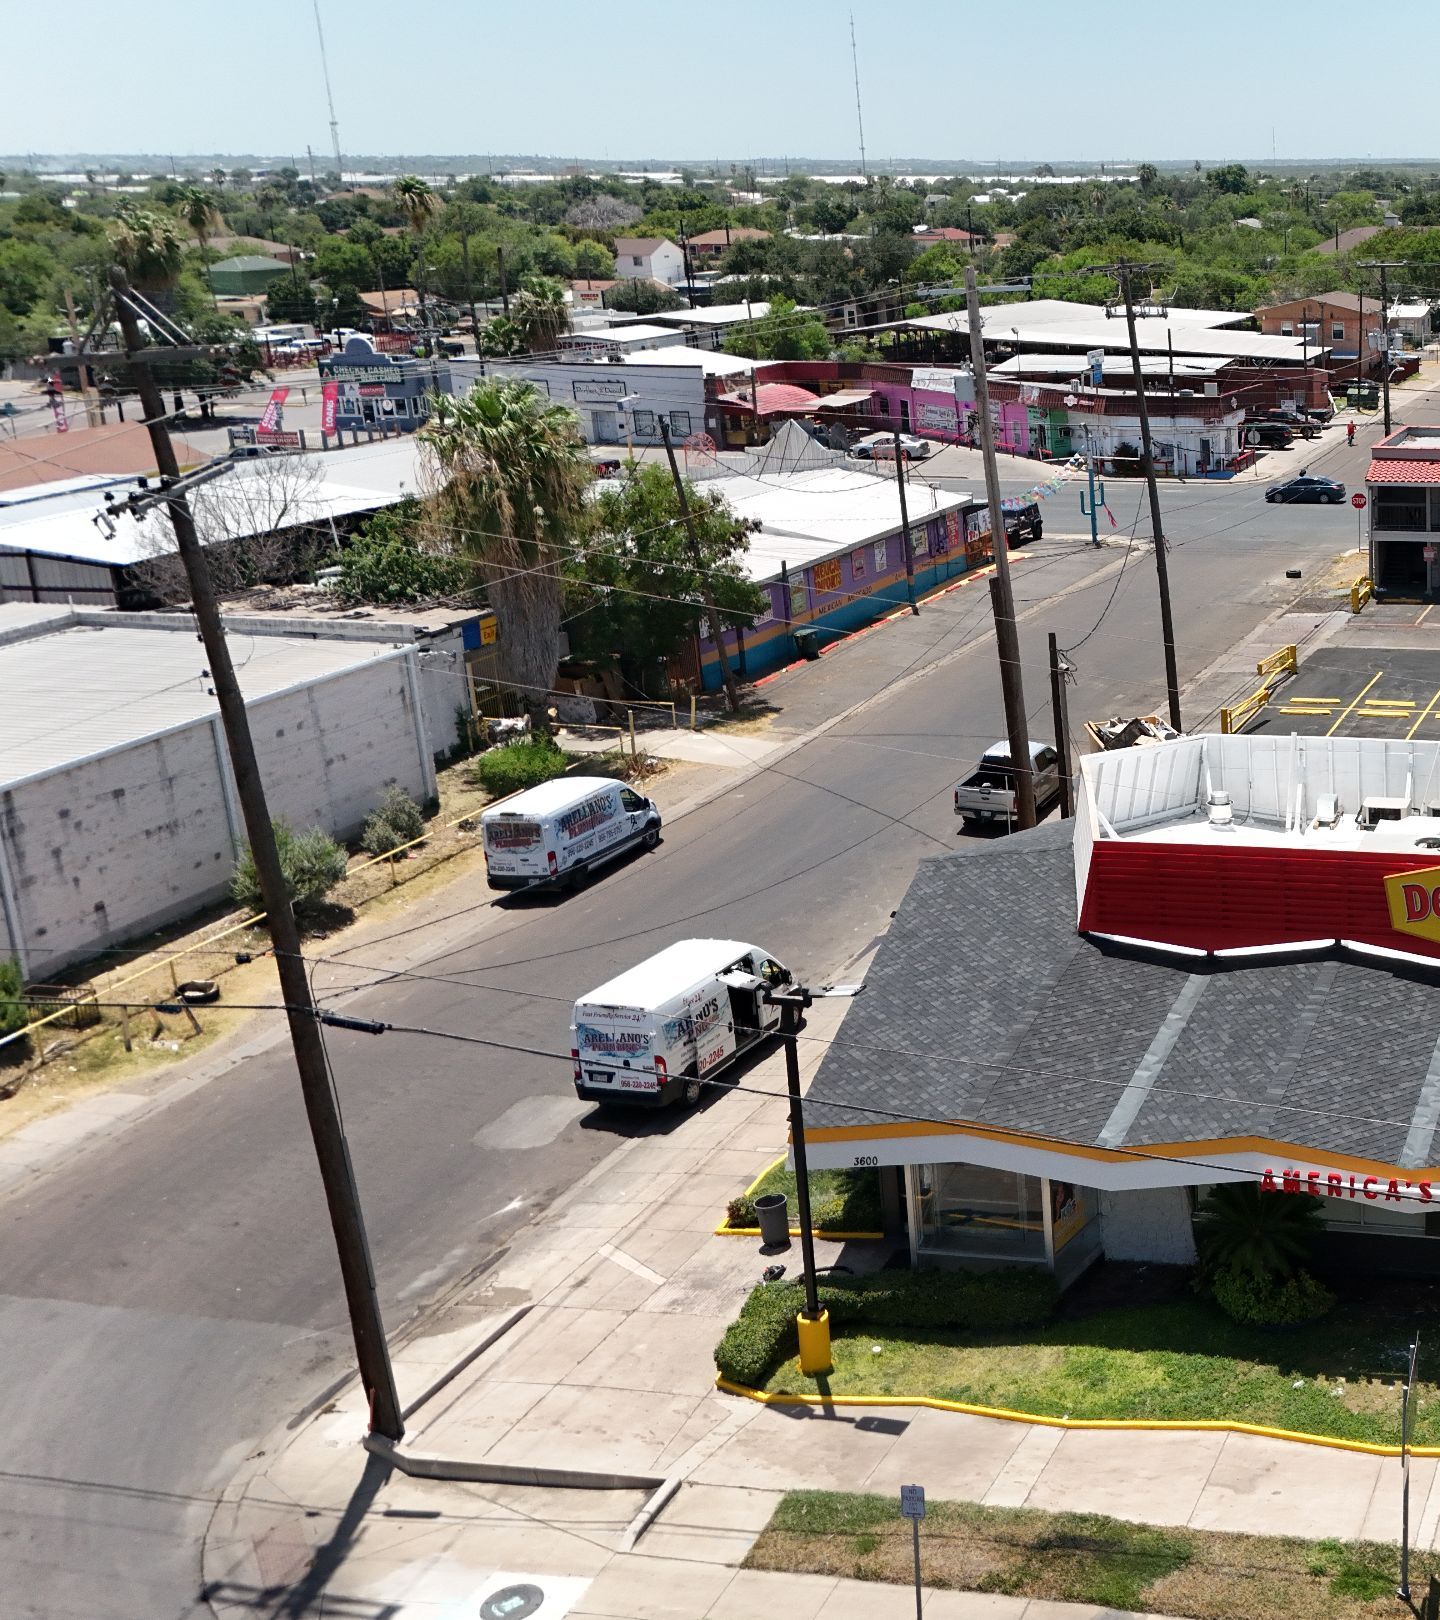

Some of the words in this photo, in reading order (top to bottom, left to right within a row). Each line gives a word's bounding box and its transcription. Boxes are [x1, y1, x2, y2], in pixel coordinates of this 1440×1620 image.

[326, 400, 335, 427] LOANS
[584, 1032, 649, 1045] ARELLANO'S
[853, 1156, 878, 1166] 3600
[1260, 1167, 1433, 1205] AMERICA'S
